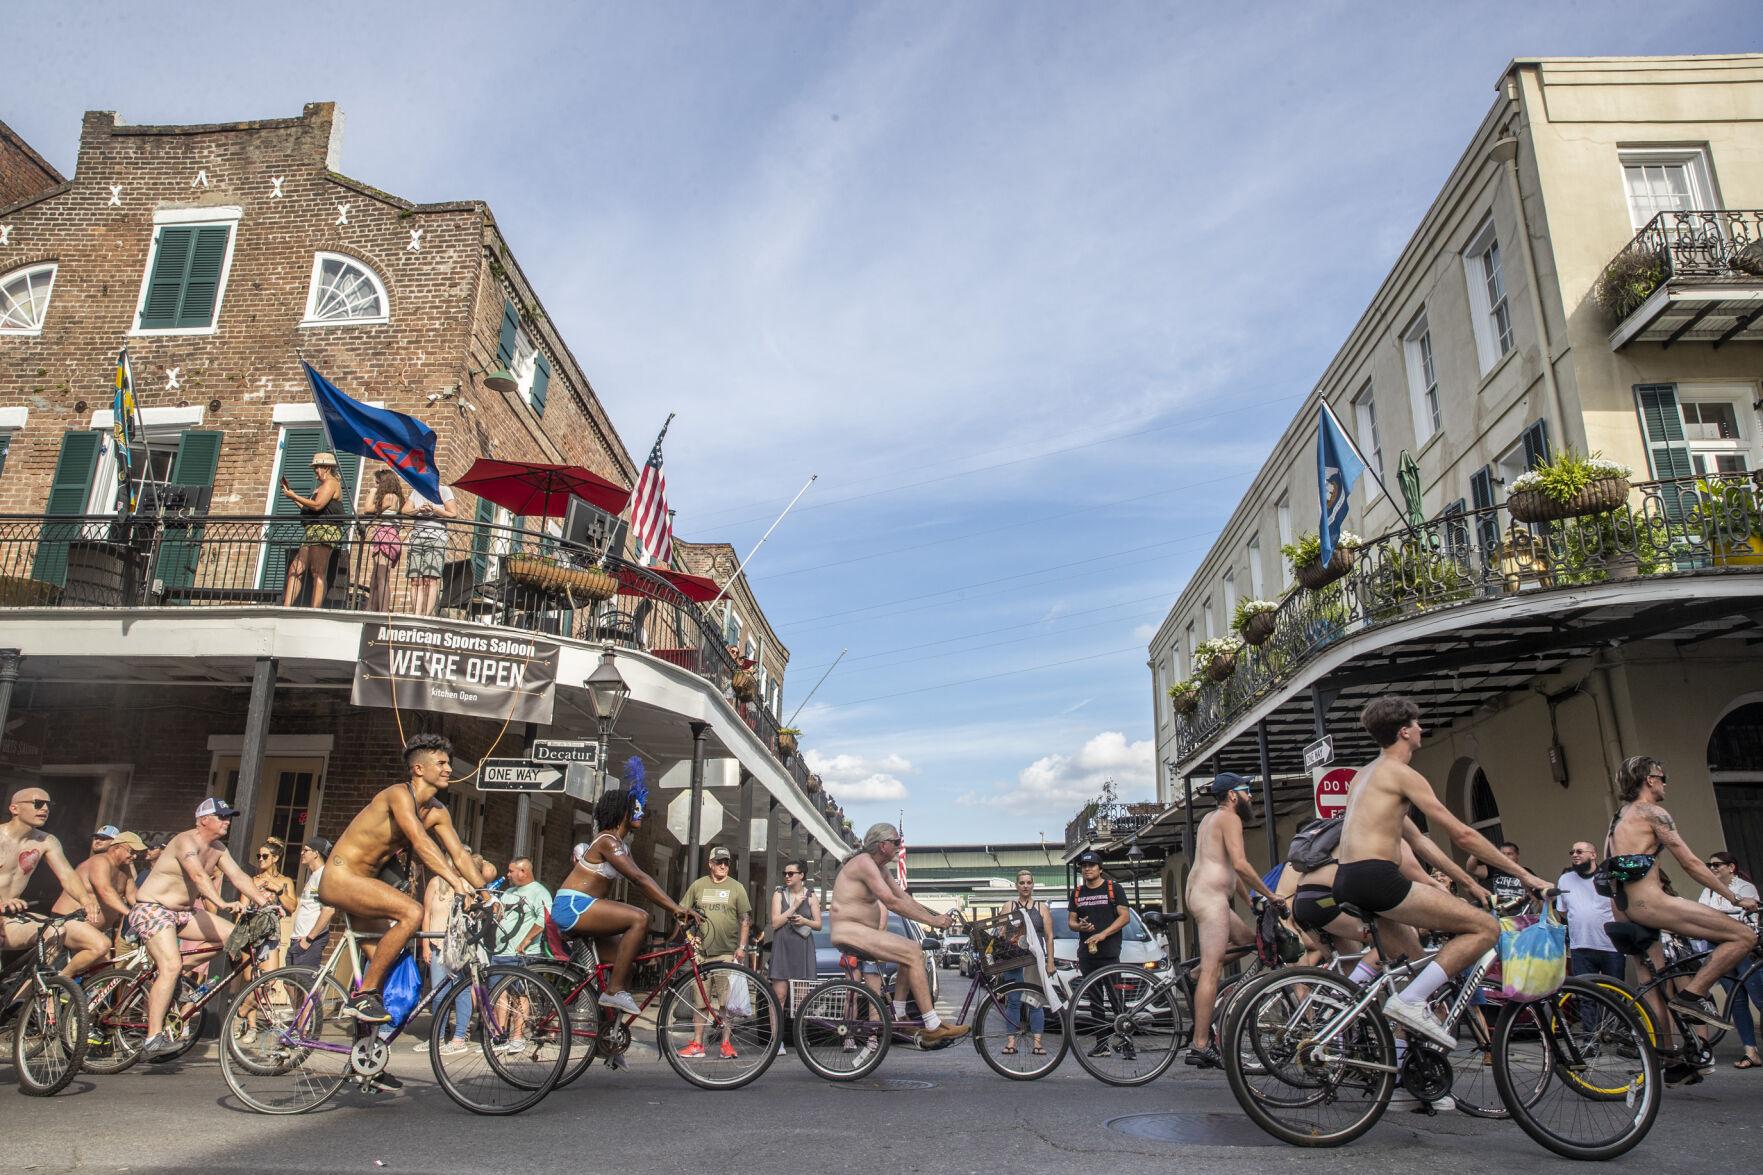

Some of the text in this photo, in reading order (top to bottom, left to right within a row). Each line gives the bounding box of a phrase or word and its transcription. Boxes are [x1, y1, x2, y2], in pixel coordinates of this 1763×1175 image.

[377, 626, 535, 657] American Sports Saloon
[389, 648, 525, 688] WE'RE OPEN
[459, 691, 478, 702] Open
[538, 747, 592, 760] Decatur
[488, 768, 542, 781] ONE WAY
[1323, 780, 1340, 791] DO
